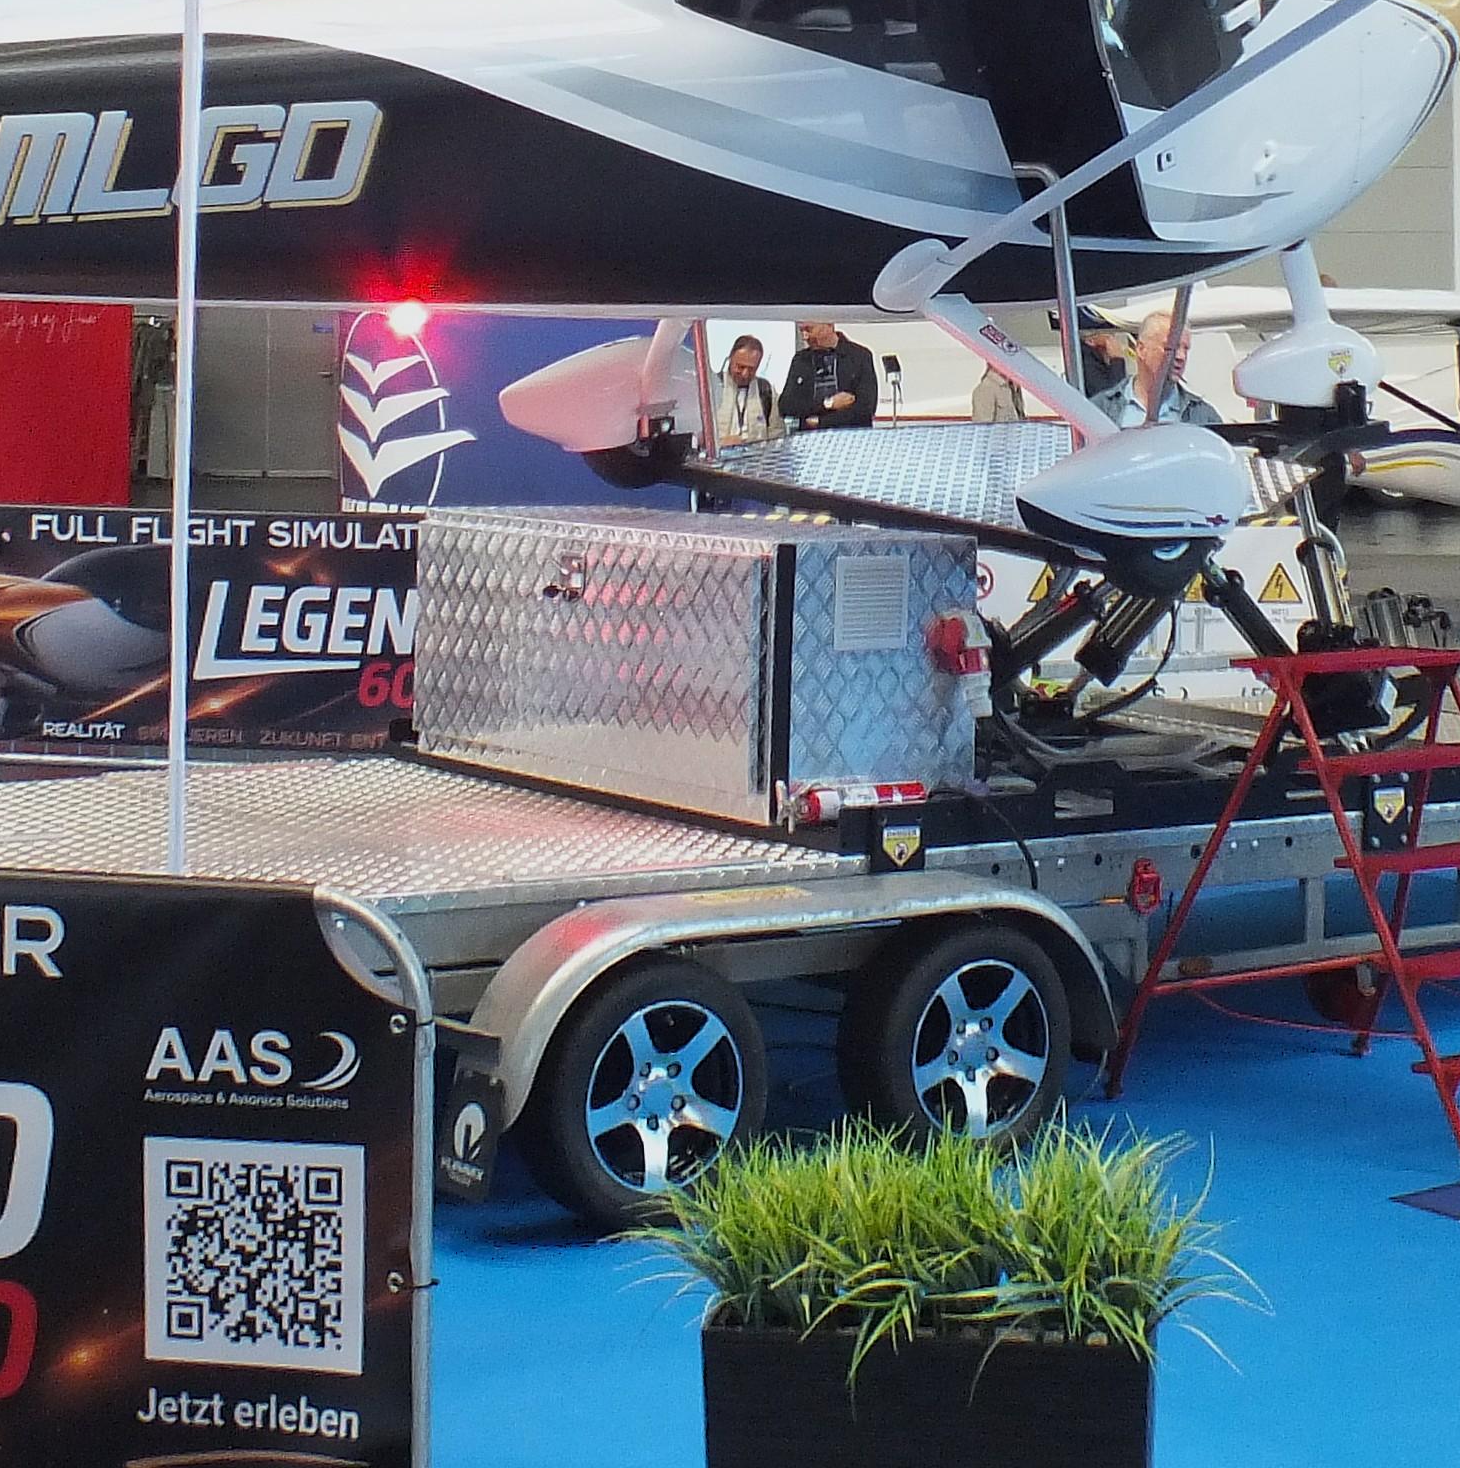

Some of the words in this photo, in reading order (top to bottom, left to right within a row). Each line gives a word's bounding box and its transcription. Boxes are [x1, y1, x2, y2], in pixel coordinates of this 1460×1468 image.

[31, 514, 118, 543] FULL
[131, 517, 256, 547] FLGHT
[268, 520, 420, 550] SIMULAT
[193, 581, 417, 681] LEGEN
[358, 663, 417, 708] 60
[42, 721, 125, 741] REALITÄT
[144, 1026, 292, 1087] AAS
[143, 1088, 214, 1105] Aerospace
[286, 1093, 349, 1110] Solutions
[137, 1387, 226, 1427] Jetzt
[234, 1393, 361, 1441] erleben
